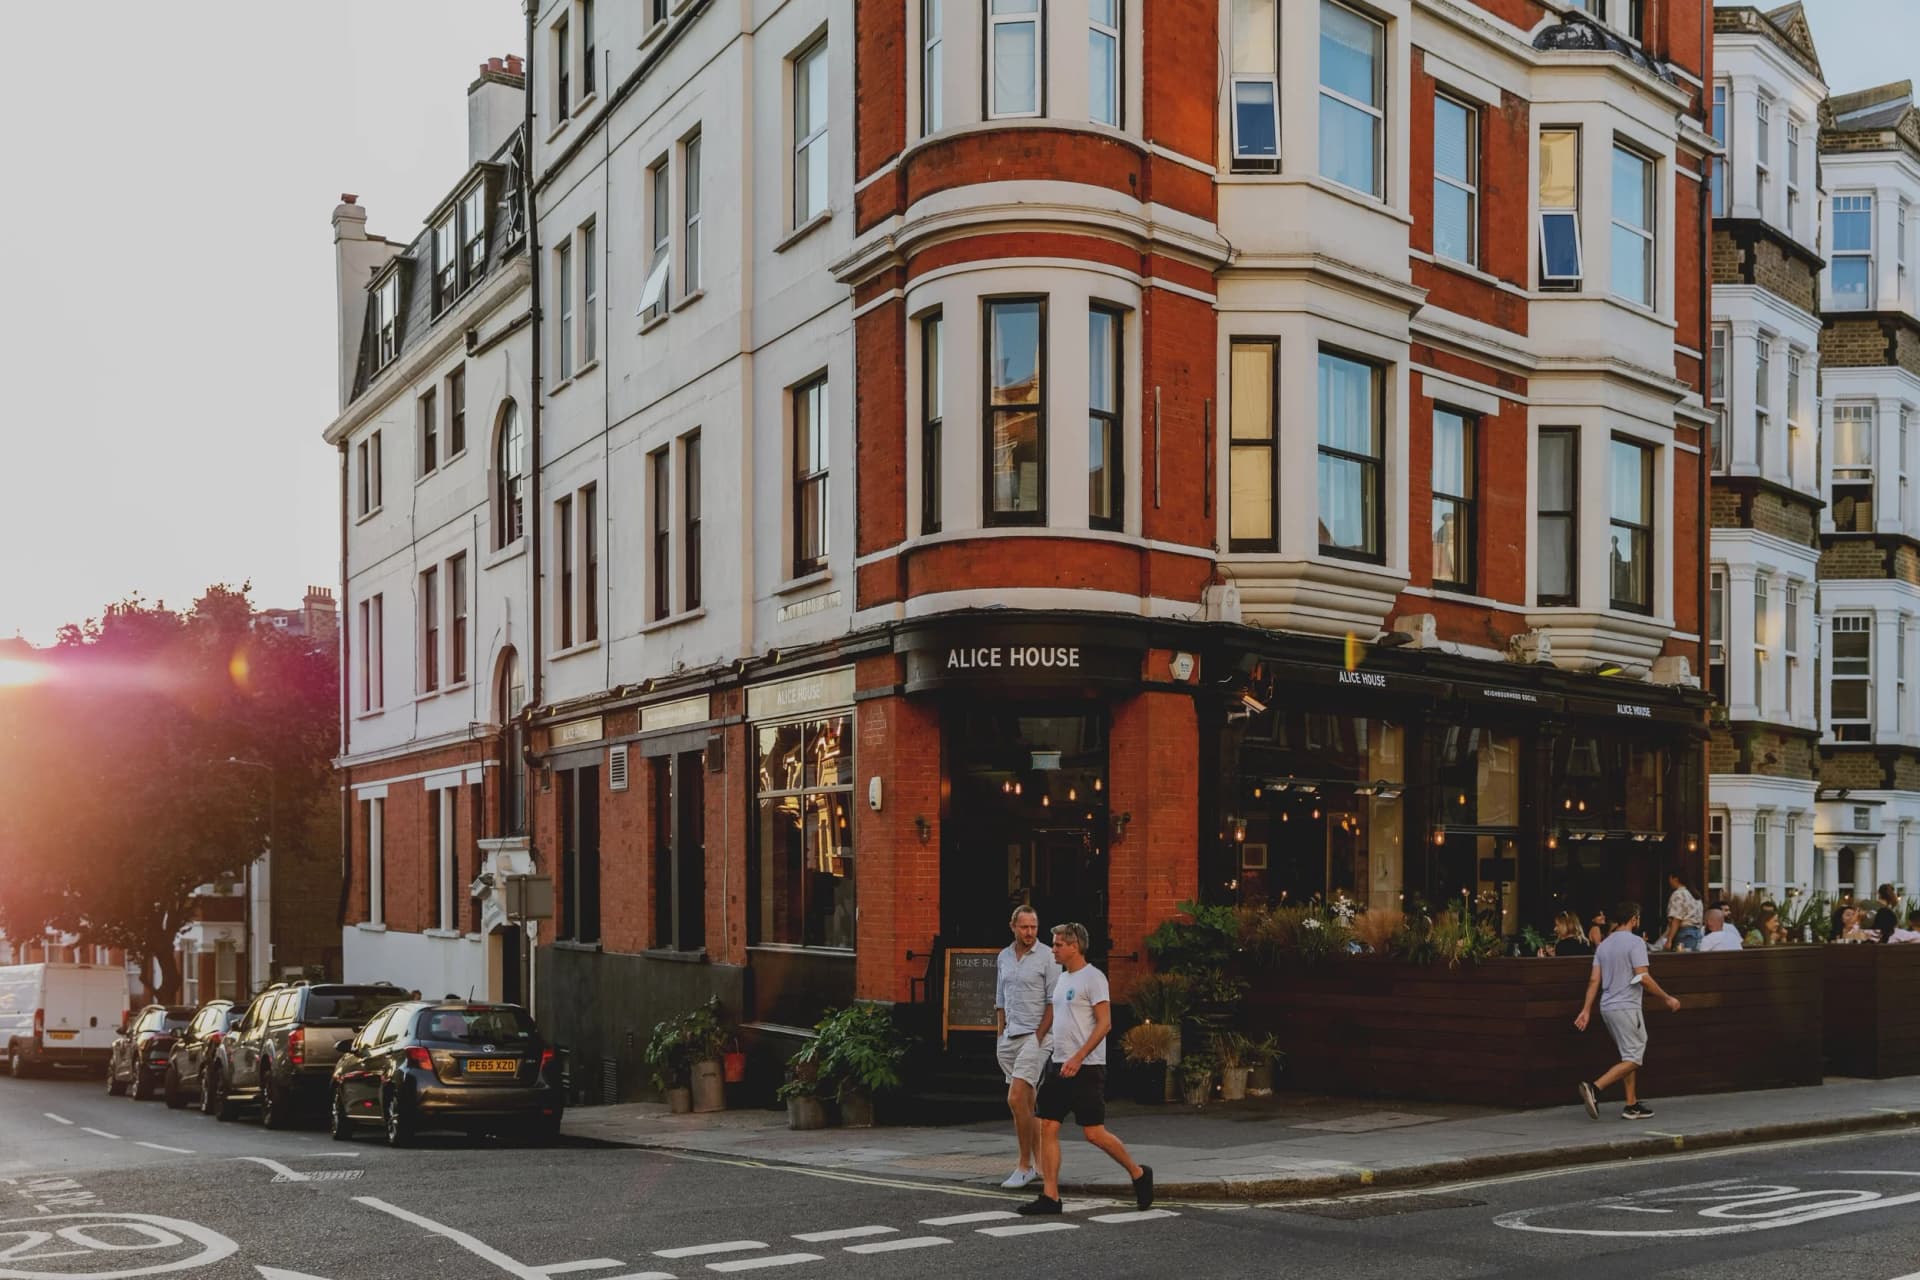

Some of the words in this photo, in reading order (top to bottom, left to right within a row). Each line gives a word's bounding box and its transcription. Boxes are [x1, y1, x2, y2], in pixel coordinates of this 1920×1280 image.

[947, 648, 1002, 669] ALICE
[1009, 647, 1080, 668] HOUSE
[1338, 671, 1362, 684] ALICE
[1361, 673, 1386, 688] HOUSE
[776, 689, 797, 705] ALICE
[798, 685, 822, 700] HOUSE
[1617, 704, 1633, 715] ALICE
[1633, 706, 1652, 717] HOUSE
[956, 957, 980, 968] HOUSE
[982, 958, 997, 968] RUL
[468, 1060, 494, 1070] PE65
